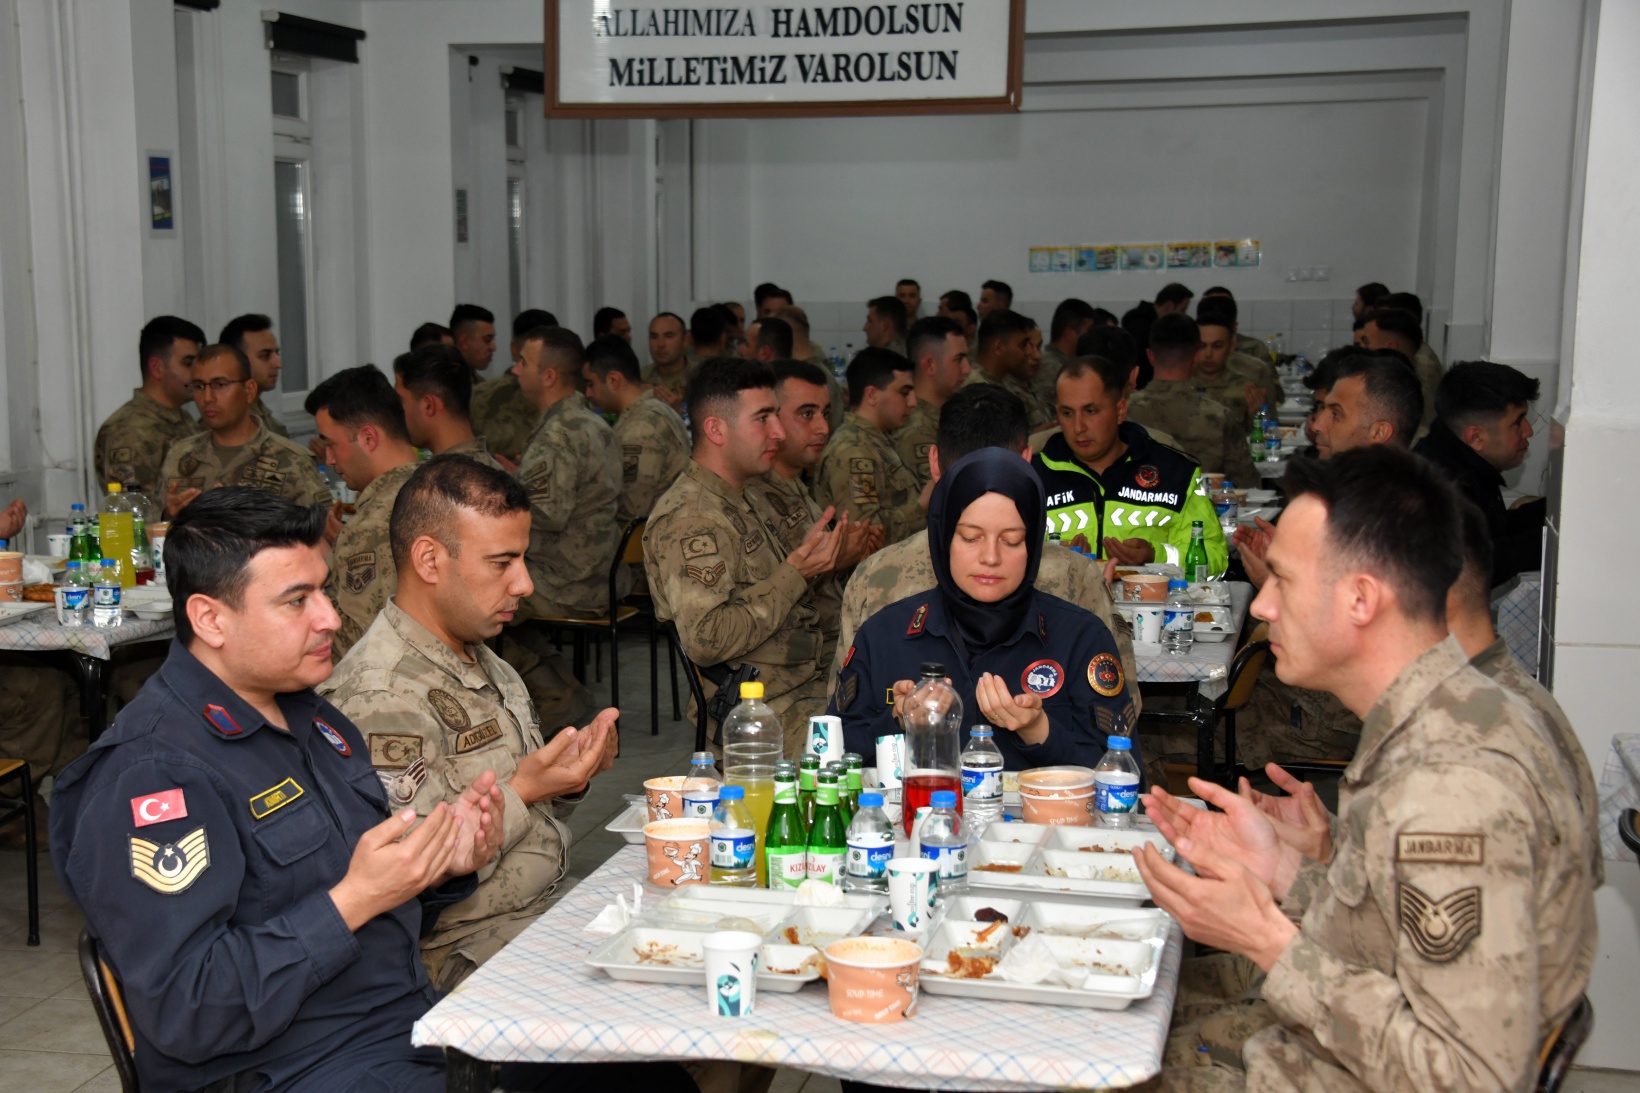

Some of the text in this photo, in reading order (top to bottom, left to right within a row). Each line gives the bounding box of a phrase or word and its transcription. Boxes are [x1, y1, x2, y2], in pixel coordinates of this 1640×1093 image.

[596, 3, 964, 38] ALLAHIMIZA HAMDOLSUN
[795, 51, 959, 84] VAROLSUN
[1046, 486, 1178, 507] AFiK JANDARMASI
[1032, 664, 1058, 677] JANDARMA
[1403, 839, 1474, 857] JANDARMA
[909, 882, 917, 894] cup
